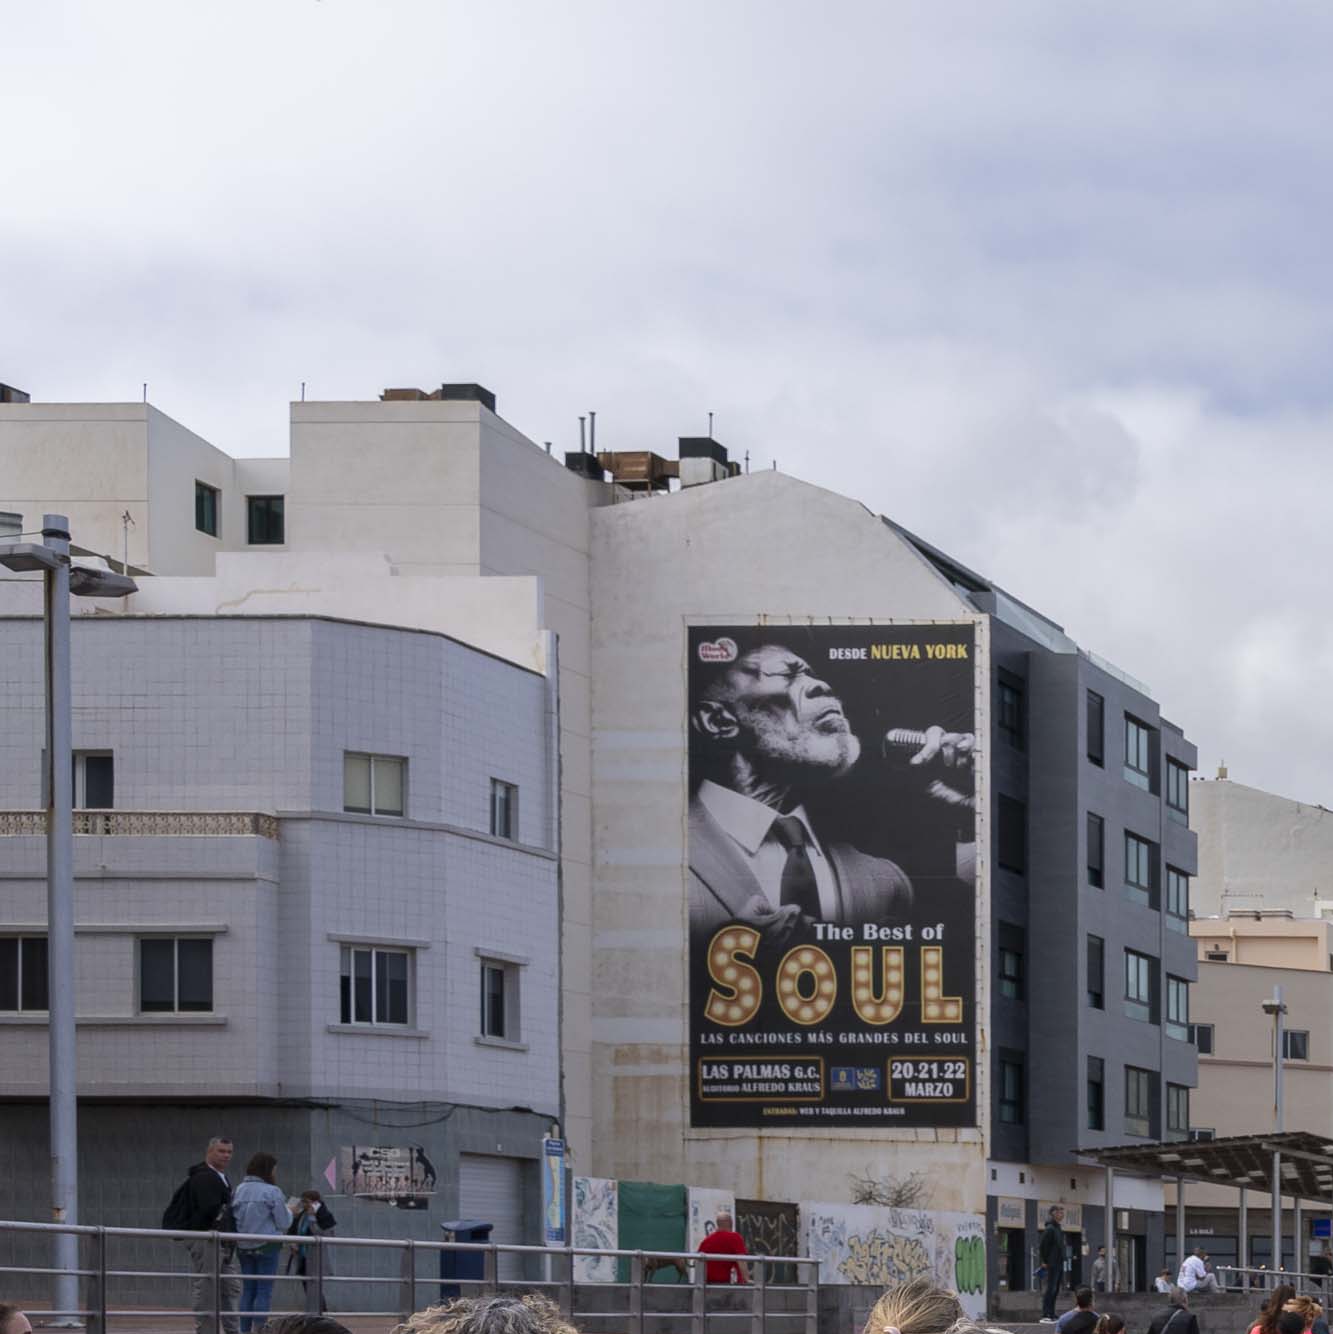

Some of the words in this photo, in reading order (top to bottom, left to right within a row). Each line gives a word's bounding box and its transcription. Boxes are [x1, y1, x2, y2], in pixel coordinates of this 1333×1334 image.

[829, 647, 868, 660] DESDE
[870, 644, 921, 660] NUEVA
[925, 644, 969, 660] YORK
[813, 923, 855, 941] The
[862, 923, 913, 941] Best
[920, 923, 945, 941] of
[703, 925, 963, 1026] SOUL
[700, 1033, 725, 1044] LAS
[729, 1033, 803, 1044] CANCIONES
[807, 1029, 834, 1044] MÁS
[839, 1032, 900, 1044] GRANDES
[904, 1032, 930, 1044] DEL
[934, 1032, 969, 1044] SOUL
[702, 1064, 729, 1079] LAS
[733, 1064, 791, 1079] PALMAS
[794, 1066, 821, 1079] G.C.
[741, 1082, 786, 1093] ALFREDO
[787, 1082, 821, 1093] KRAUS
[904, 1082, 954, 1097] MARZO
